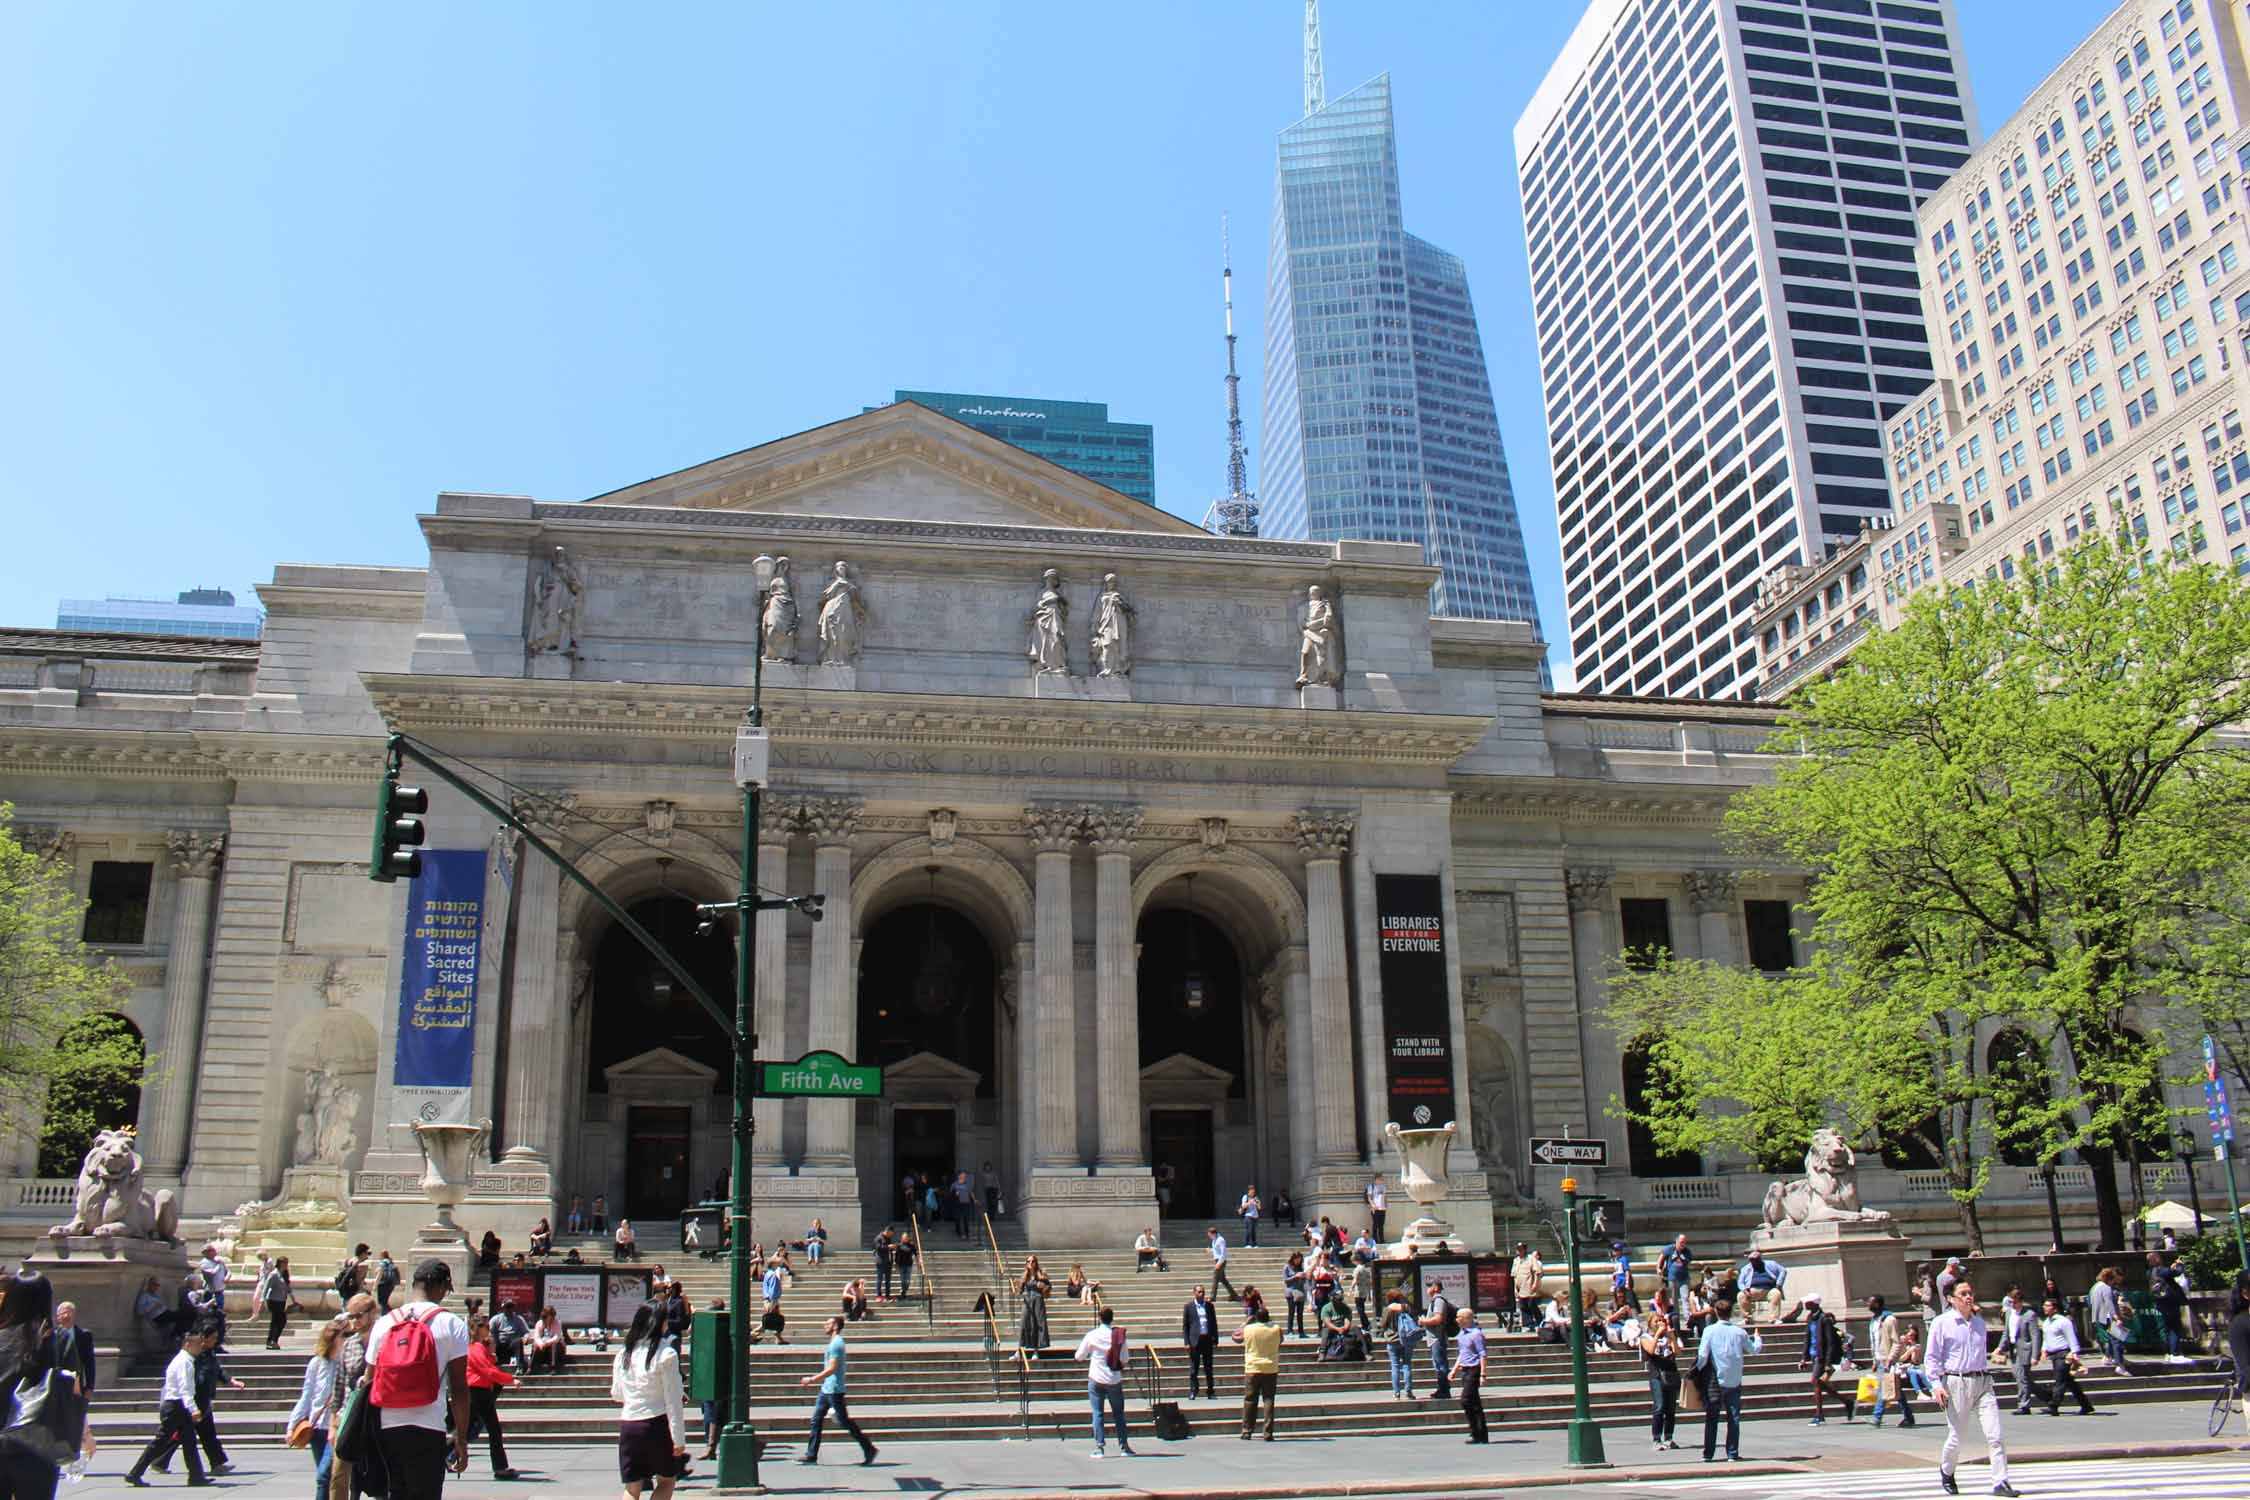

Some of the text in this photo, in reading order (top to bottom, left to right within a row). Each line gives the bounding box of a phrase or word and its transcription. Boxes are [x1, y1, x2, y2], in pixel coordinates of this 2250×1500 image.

[769, 745, 840, 768] NEW
[866, 750, 938, 771] YORK
[962, 752, 1057, 775] PUBLIC
[1082, 757, 1192, 782] LIBRARY
[1382, 916, 1440, 929] LIBRARIES
[1394, 930, 1429, 938] ARE FOR
[426, 941, 475, 955] Shared
[1383, 938, 1441, 952] EVERYONE
[426, 956, 475, 969] Sacred
[438, 970, 474, 984] Sites
[1396, 1038, 1440, 1047] STAND WITH
[1392, 1048, 1445, 1057] YOUR LIBRARY
[781, 1071, 864, 1090] Fifth Ave
[1542, 1147, 1597, 1158] ONE WAY
